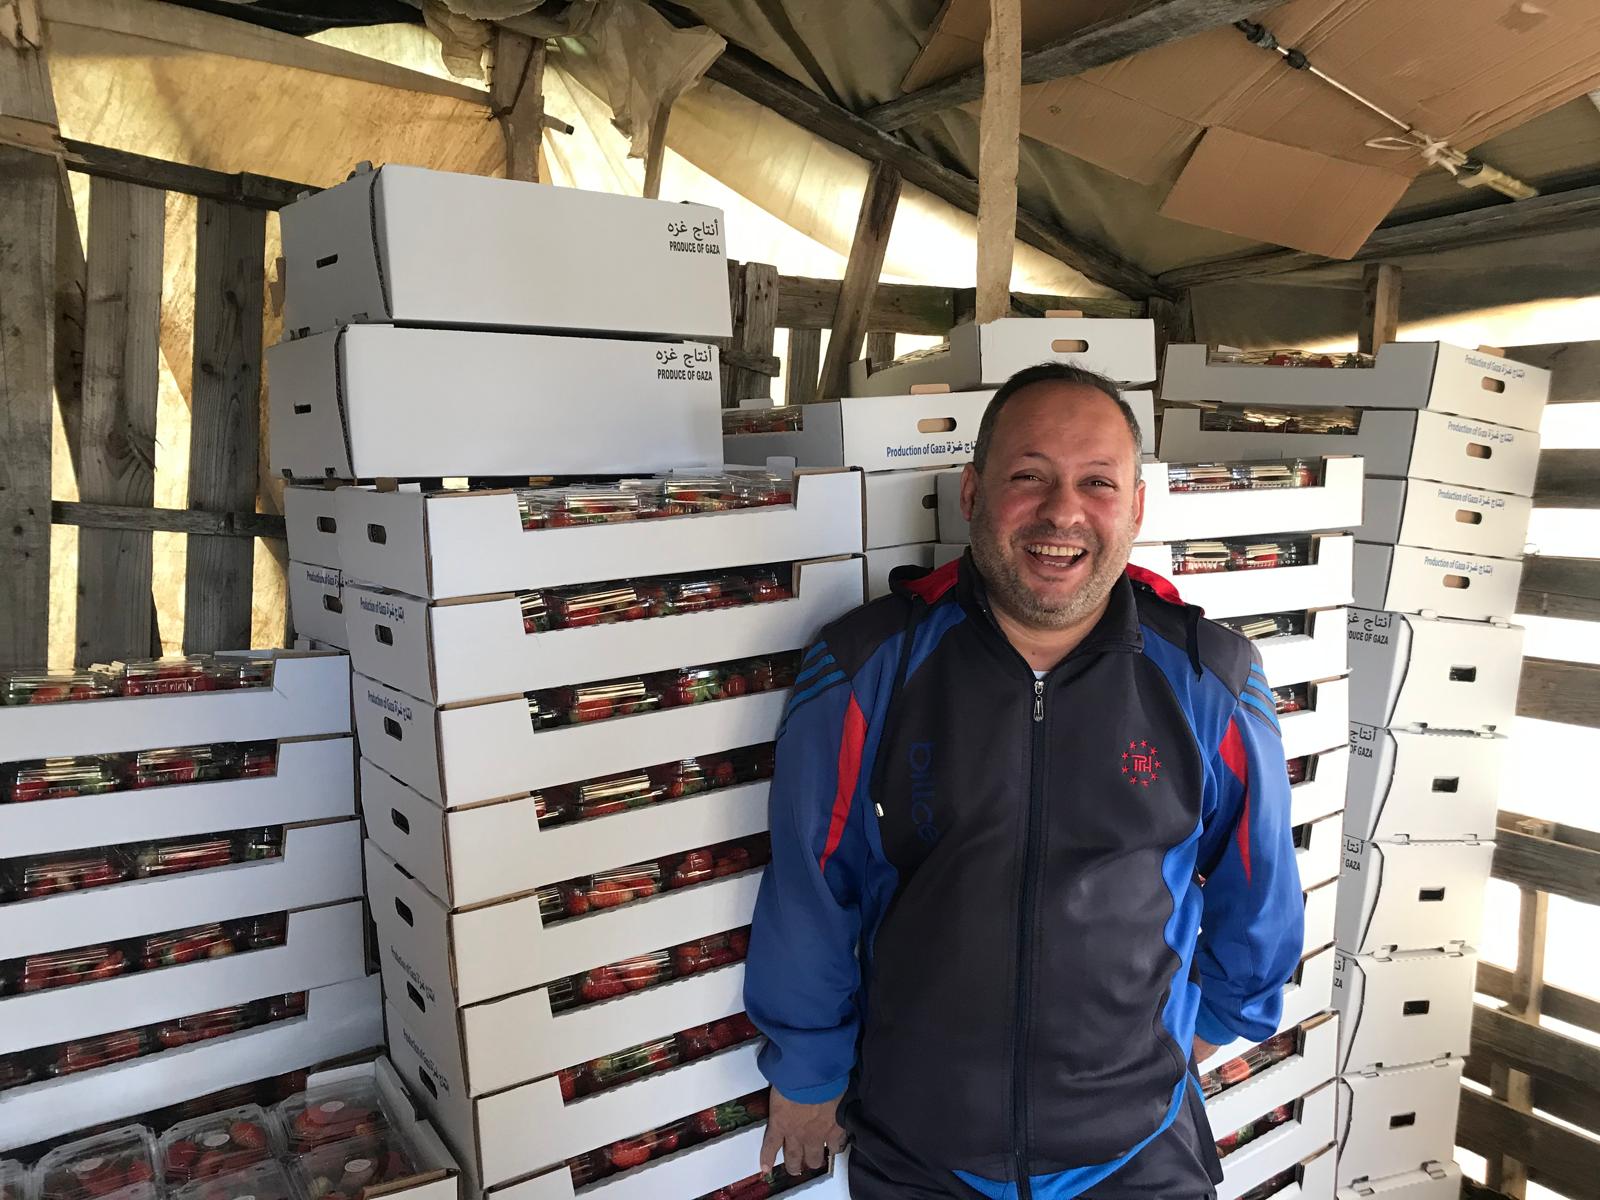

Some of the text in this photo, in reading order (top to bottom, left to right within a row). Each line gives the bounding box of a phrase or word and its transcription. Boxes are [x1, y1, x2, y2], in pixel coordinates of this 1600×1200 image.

[667, 218, 719, 241] أنتاج غزه
[669, 240, 721, 255] PRODUCE OF GAZA
[655, 345, 712, 368] أنتاج غزه
[657, 368, 713, 381] PRODUCE OF GAZA
[886, 443, 946, 458] Production of Gaza
[1347, 612, 1392, 631] أنتاج غز
[1364, 632, 1372, 642] OF
[1372, 634, 1389, 645] GAZA
[1357, 746, 1373, 758] GAZA
[1343, 839, 1365, 855] أنتا
[1345, 858, 1361, 871] GAZA
[1334, 977, 1343, 989] ZA
